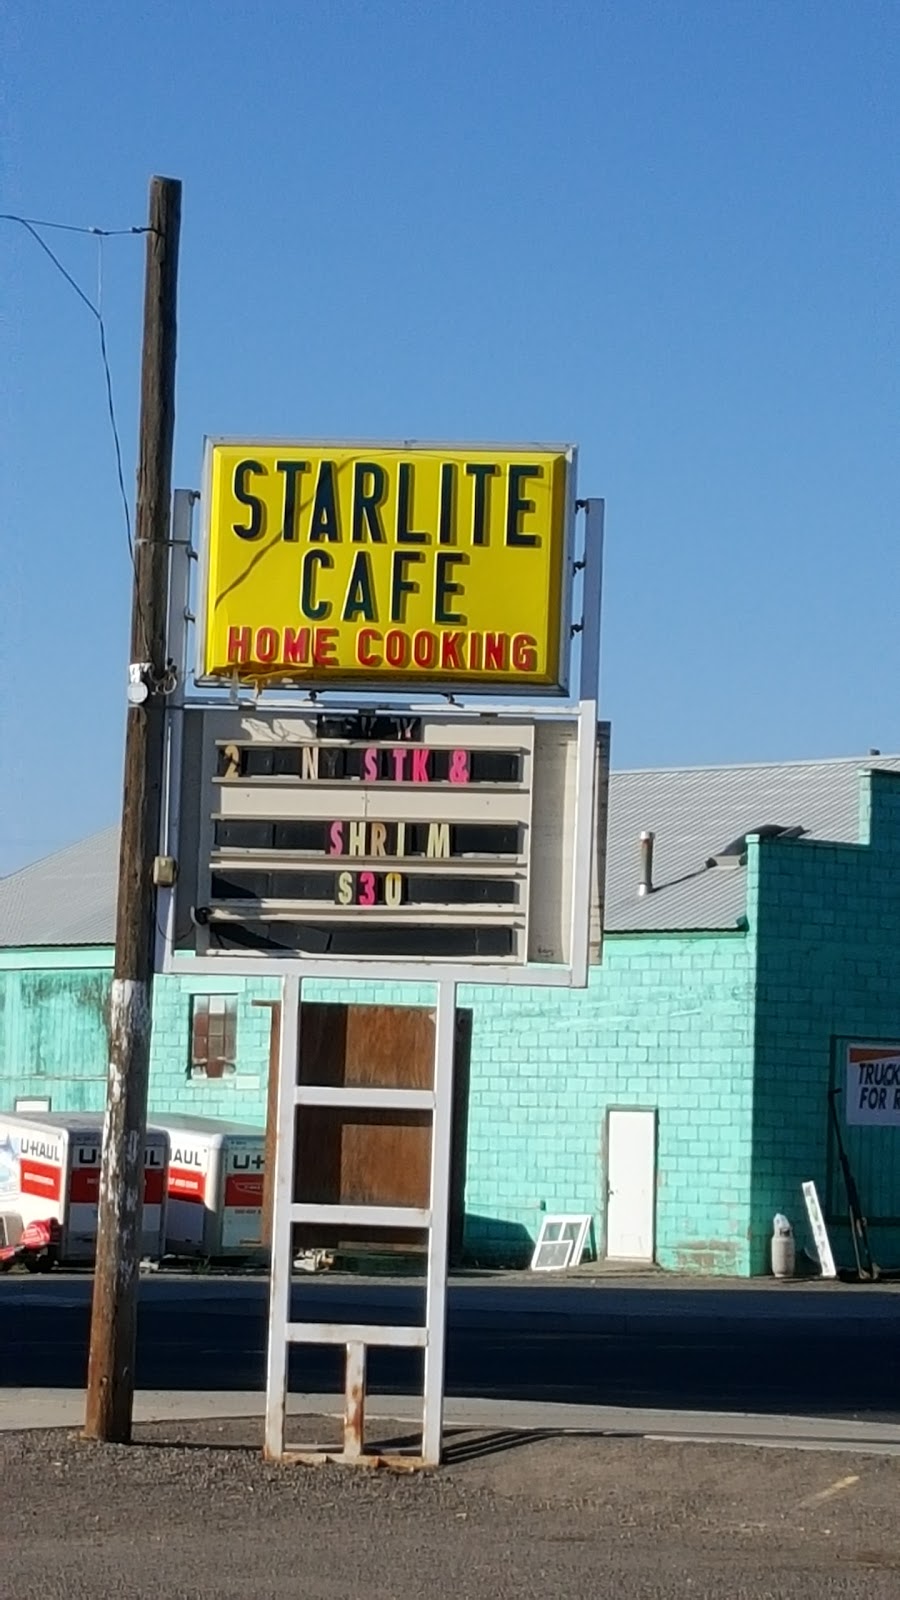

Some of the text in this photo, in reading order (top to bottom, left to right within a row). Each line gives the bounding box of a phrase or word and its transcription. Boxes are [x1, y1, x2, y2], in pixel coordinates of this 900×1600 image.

[232, 459, 542, 547] STARLITE
[301, 548, 469, 624] CAFE
[227, 626, 537, 672] HOME COOKING
[223, 745, 240, 778] 2
[364, 747, 430, 783] STK
[448, 749, 470, 784] &
[859, 1087, 888, 1110] FOR
